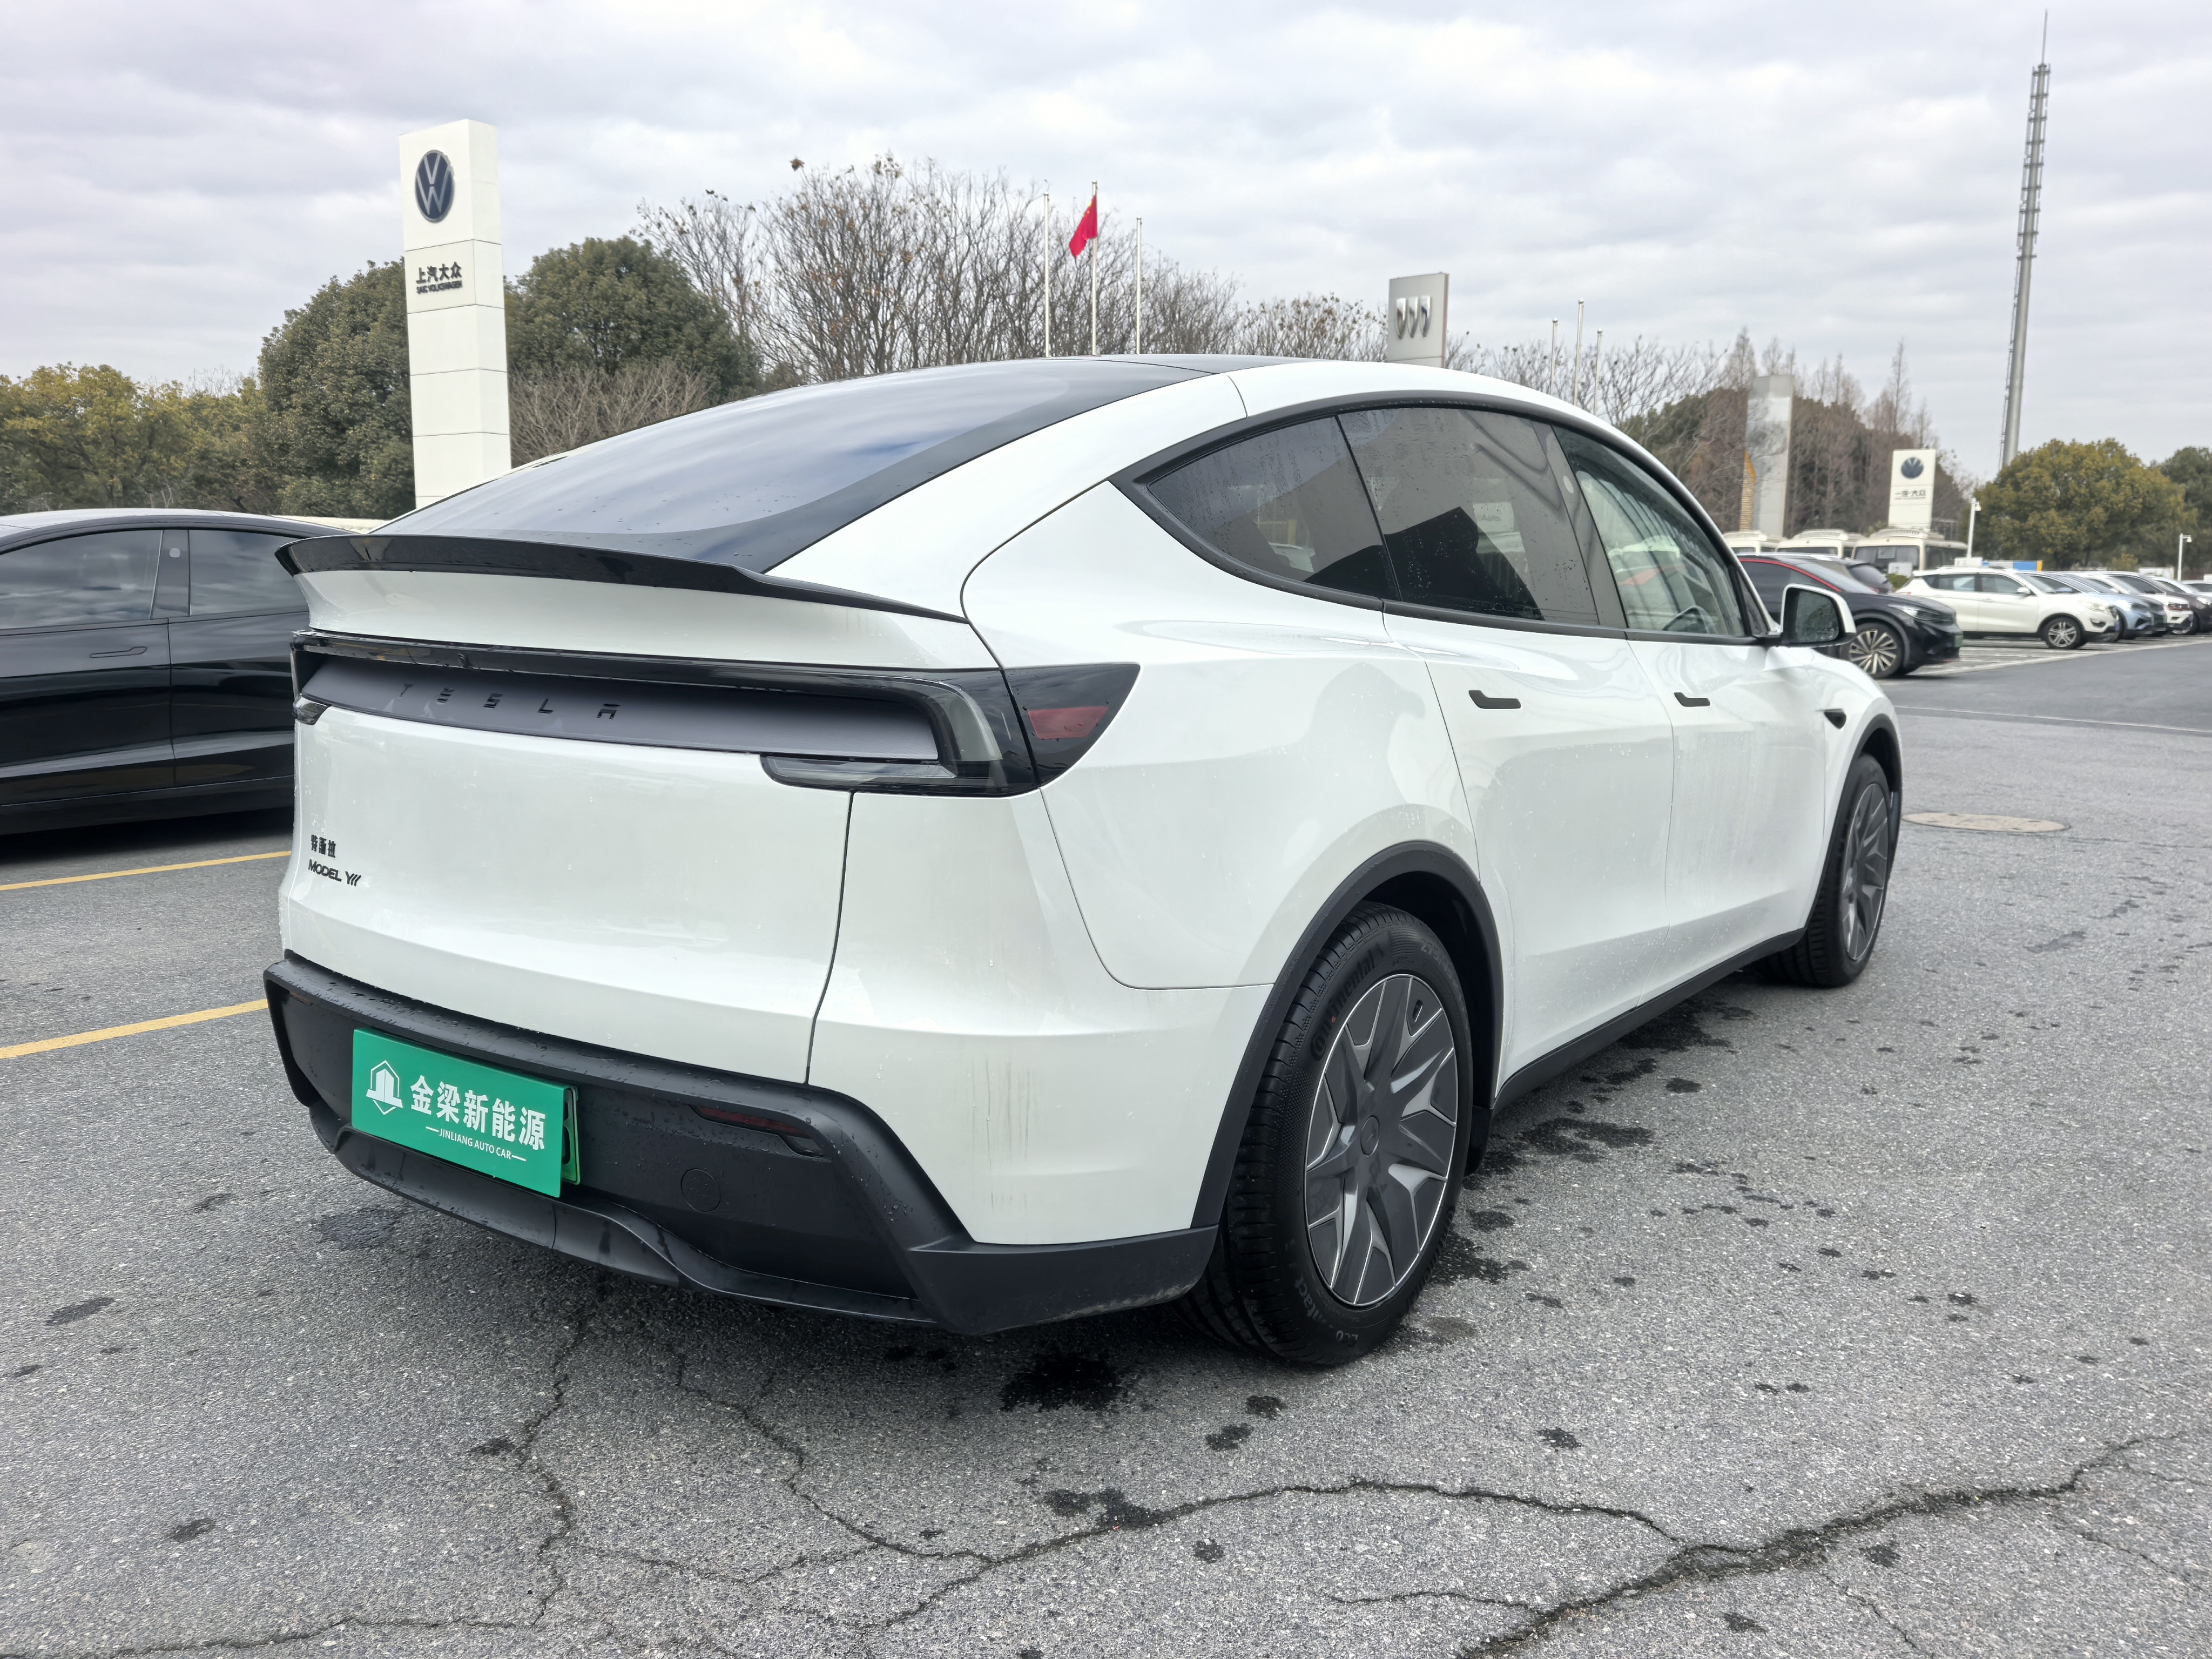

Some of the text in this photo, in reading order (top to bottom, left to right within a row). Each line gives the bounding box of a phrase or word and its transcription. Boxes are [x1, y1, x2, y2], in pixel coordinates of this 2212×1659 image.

[416, 261, 462, 284] 上汽大众
[399, 682, 621, 720] TESLA
[311, 834, 335, 858] 特斯拉
[308, 859, 342, 882] MODEL
[410, 1075, 546, 1150] 金梁新能源
[439, 1128, 511, 1160] JINLIANG AUTO CAR
